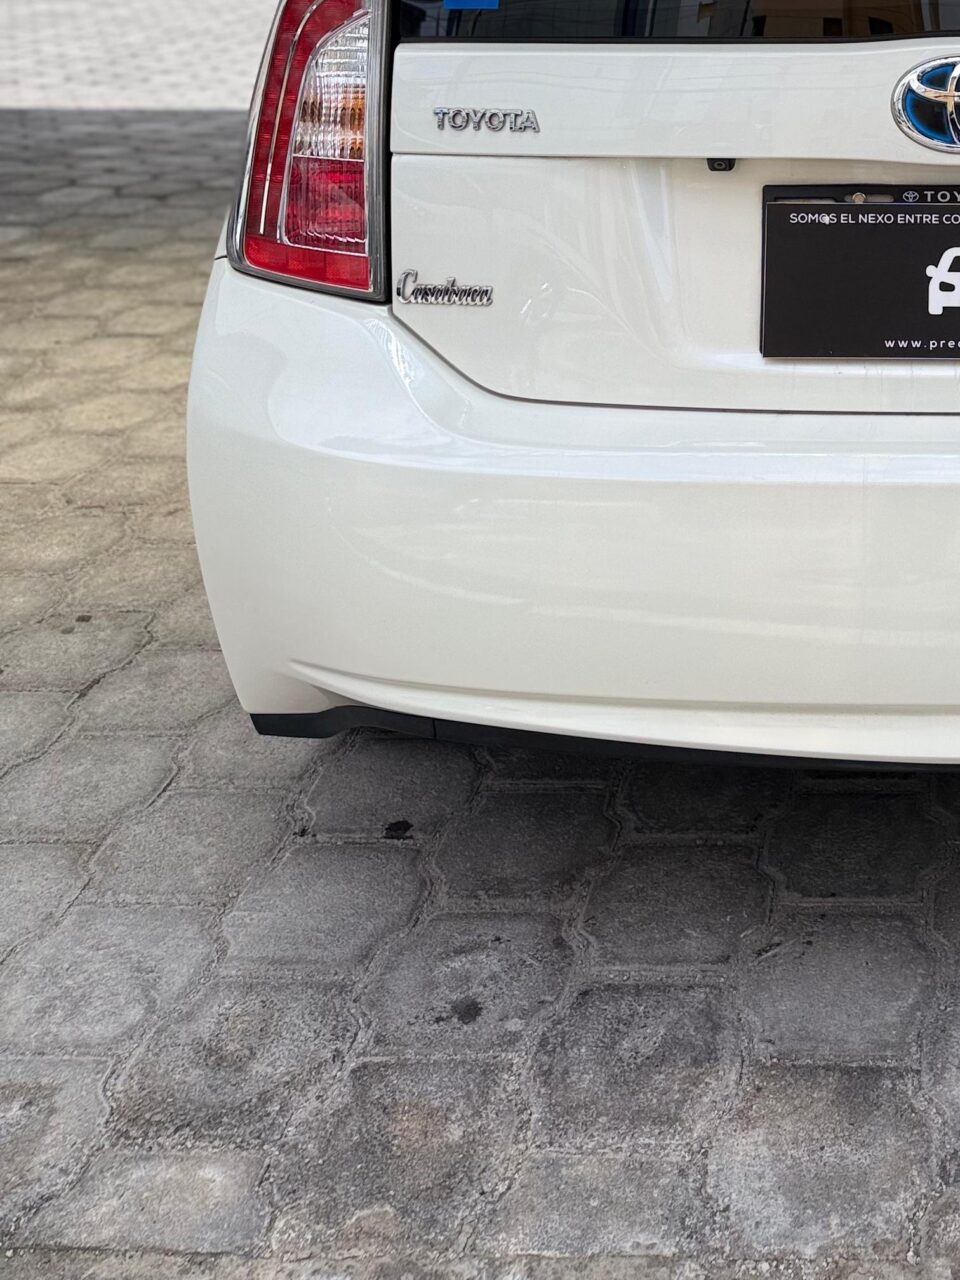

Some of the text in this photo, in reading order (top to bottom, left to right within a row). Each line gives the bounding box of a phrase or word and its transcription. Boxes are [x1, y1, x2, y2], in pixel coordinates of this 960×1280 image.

[433, 106, 540, 133] TOYOTA
[789, 213, 837, 225] SOMOS
[840, 214, 855, 224] EL
[858, 214, 894, 224] NEXO
[897, 214, 940, 225] ENTRE
